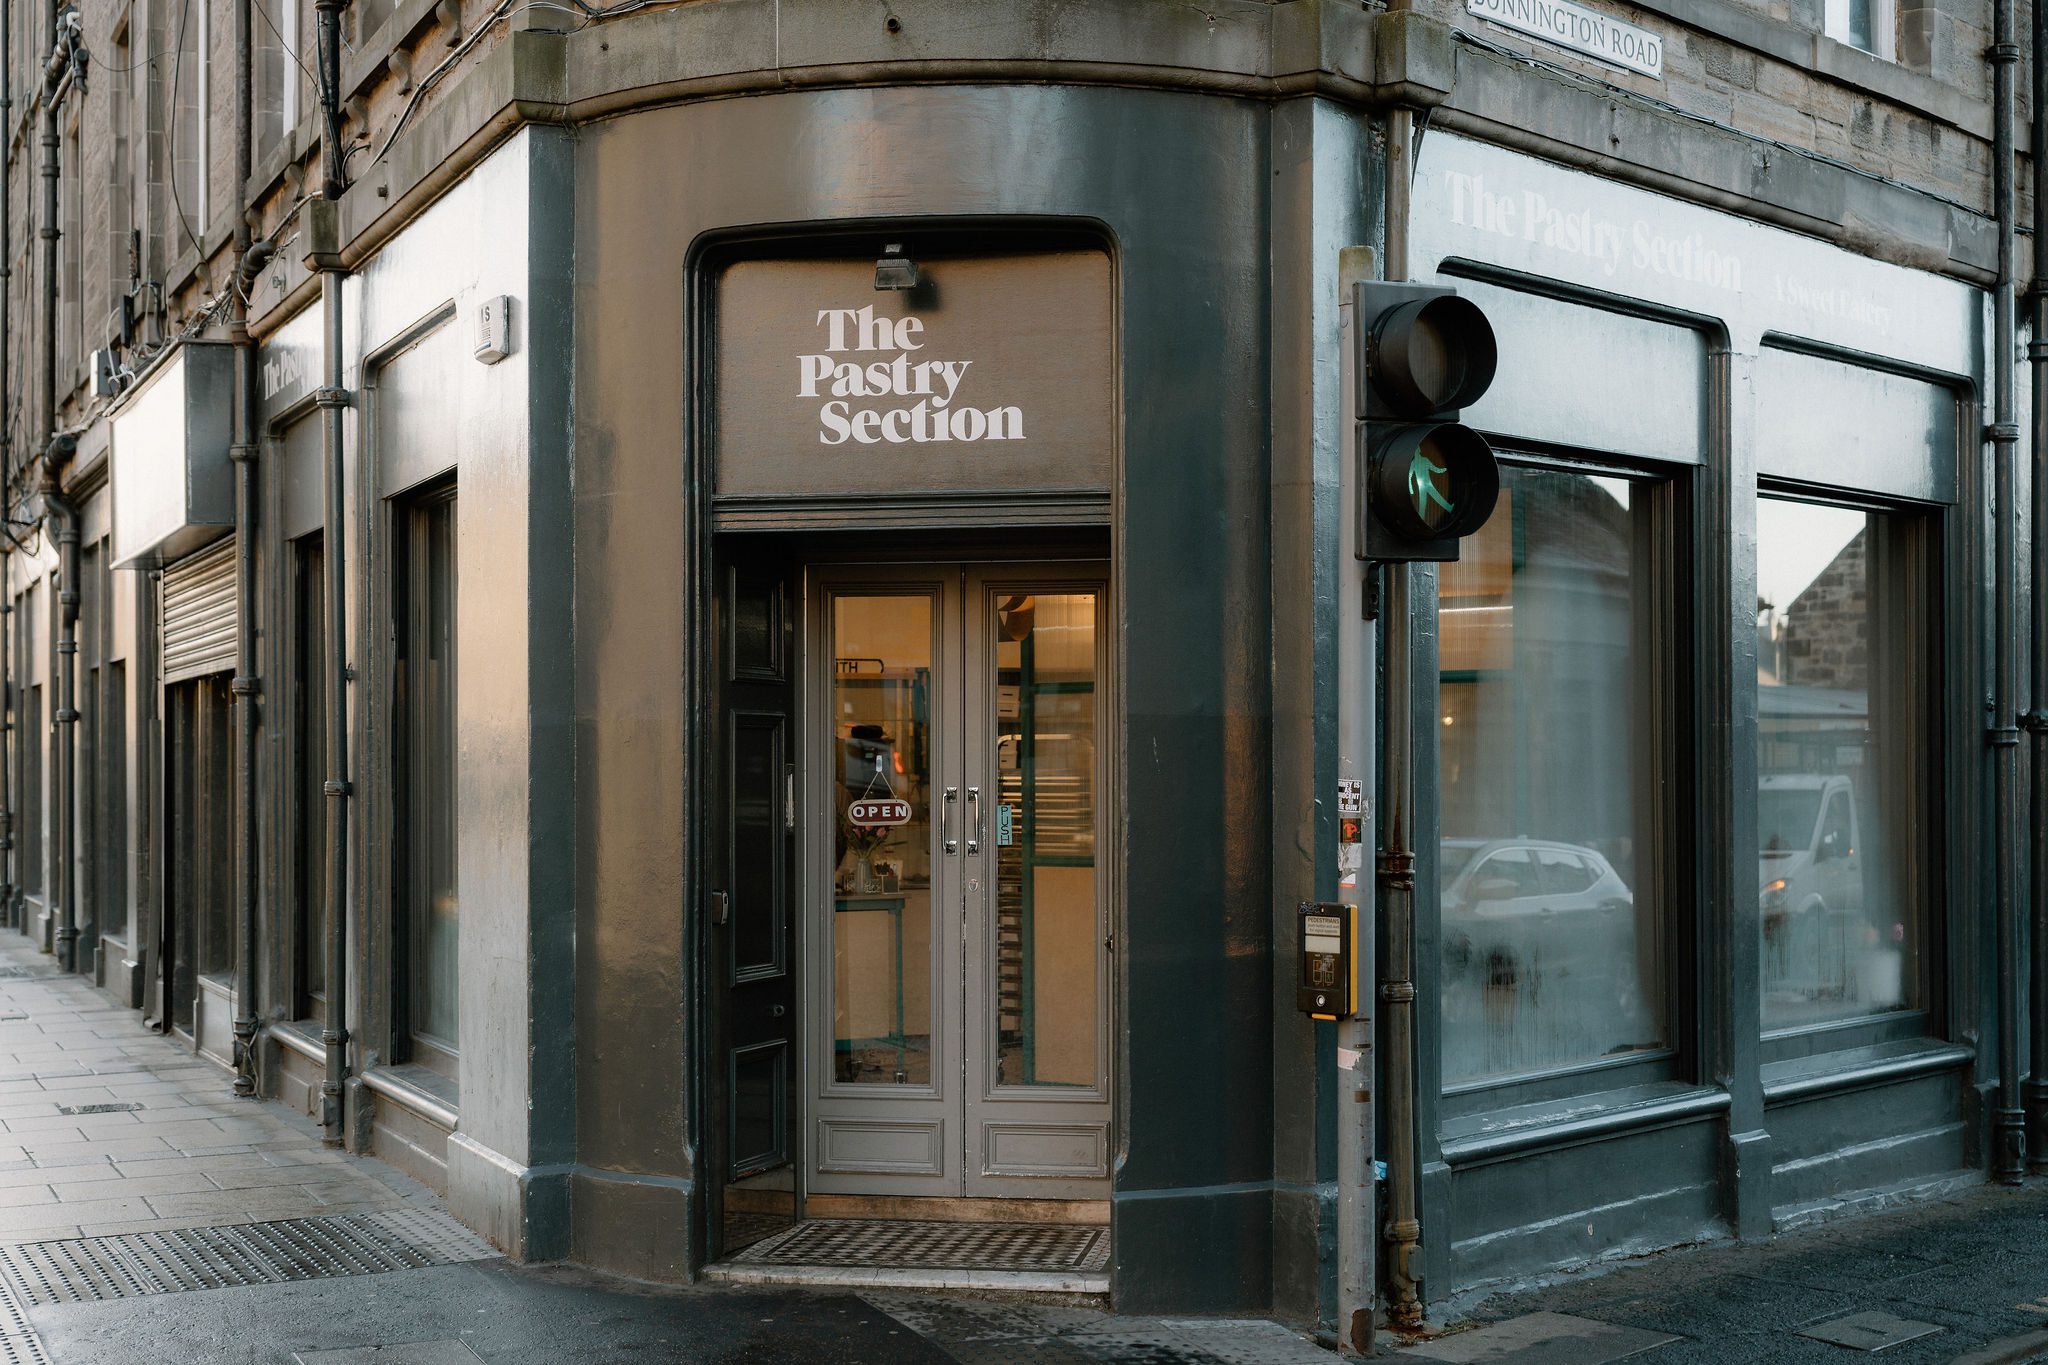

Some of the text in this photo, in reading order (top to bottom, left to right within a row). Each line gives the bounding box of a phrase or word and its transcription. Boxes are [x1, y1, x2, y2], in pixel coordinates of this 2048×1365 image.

[1475, 0, 1658, 68] NNINGTON ROAD
[1444, 169, 1744, 293] The Pastry Section
[1787, 274, 1835, 316] Sweet
[816, 304, 925, 352] The
[263, 357, 280, 401] The
[796, 351, 974, 408] Pastry
[819, 399, 1027, 445] Section
[852, 805, 907, 817] OPEN
[1000, 806, 1010, 845] PUSH
